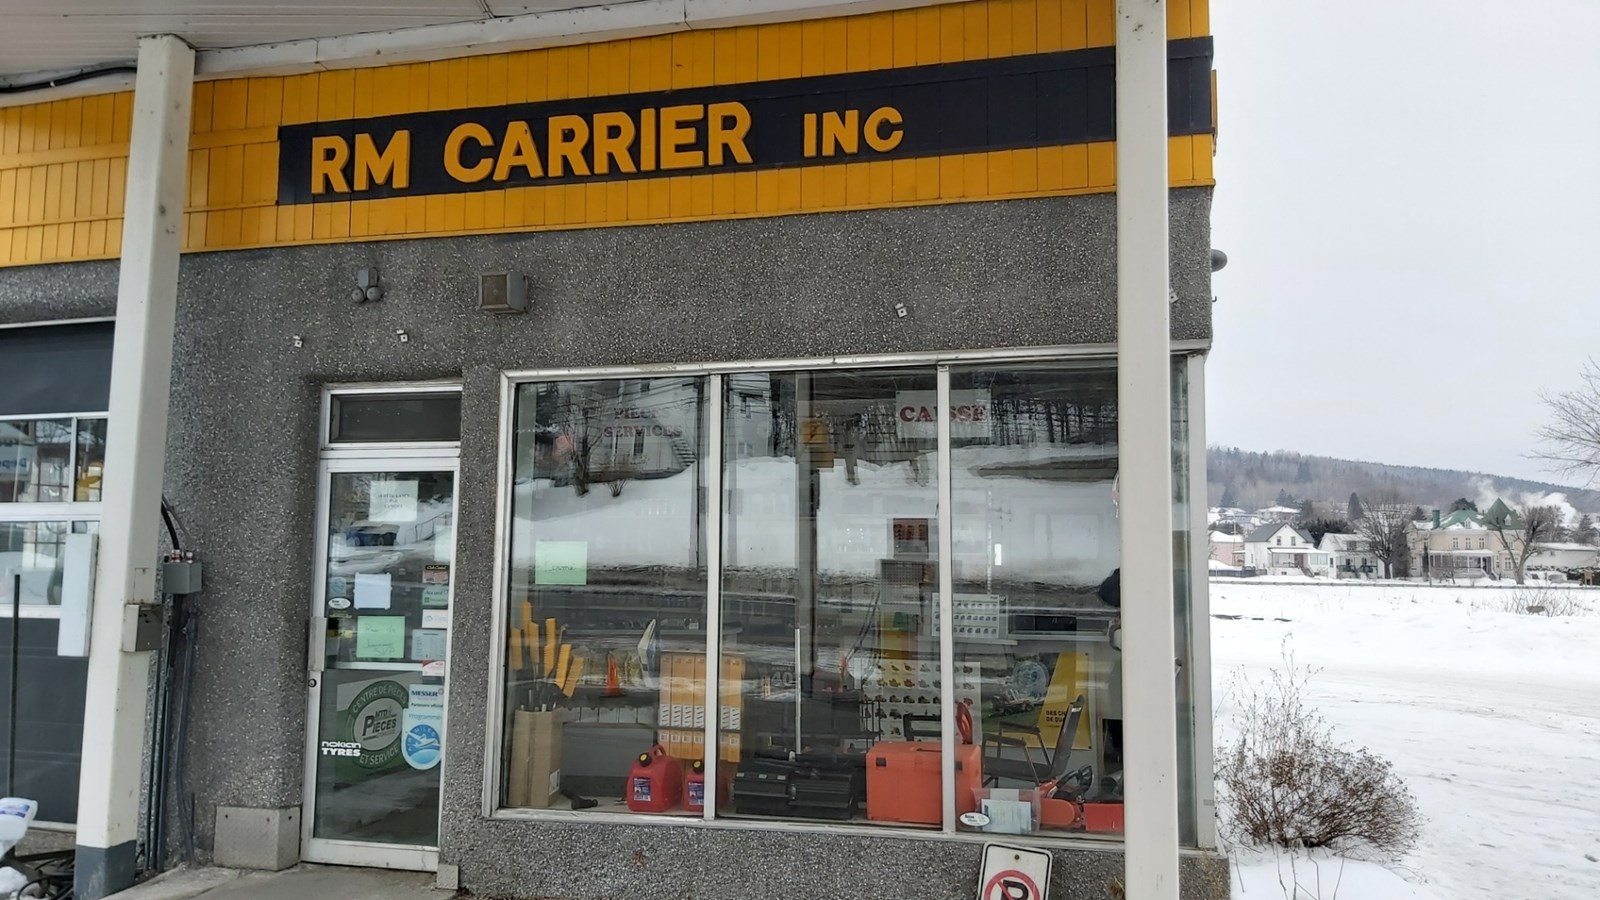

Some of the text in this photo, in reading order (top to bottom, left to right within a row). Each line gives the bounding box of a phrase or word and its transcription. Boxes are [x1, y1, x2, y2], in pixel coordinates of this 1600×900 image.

[311, 101, 905, 195] RM CARRIER INC
[352, 686, 380, 713] CENTRE
[321, 741, 361, 749] nokian
[321, 747, 361, 757] TYRES
